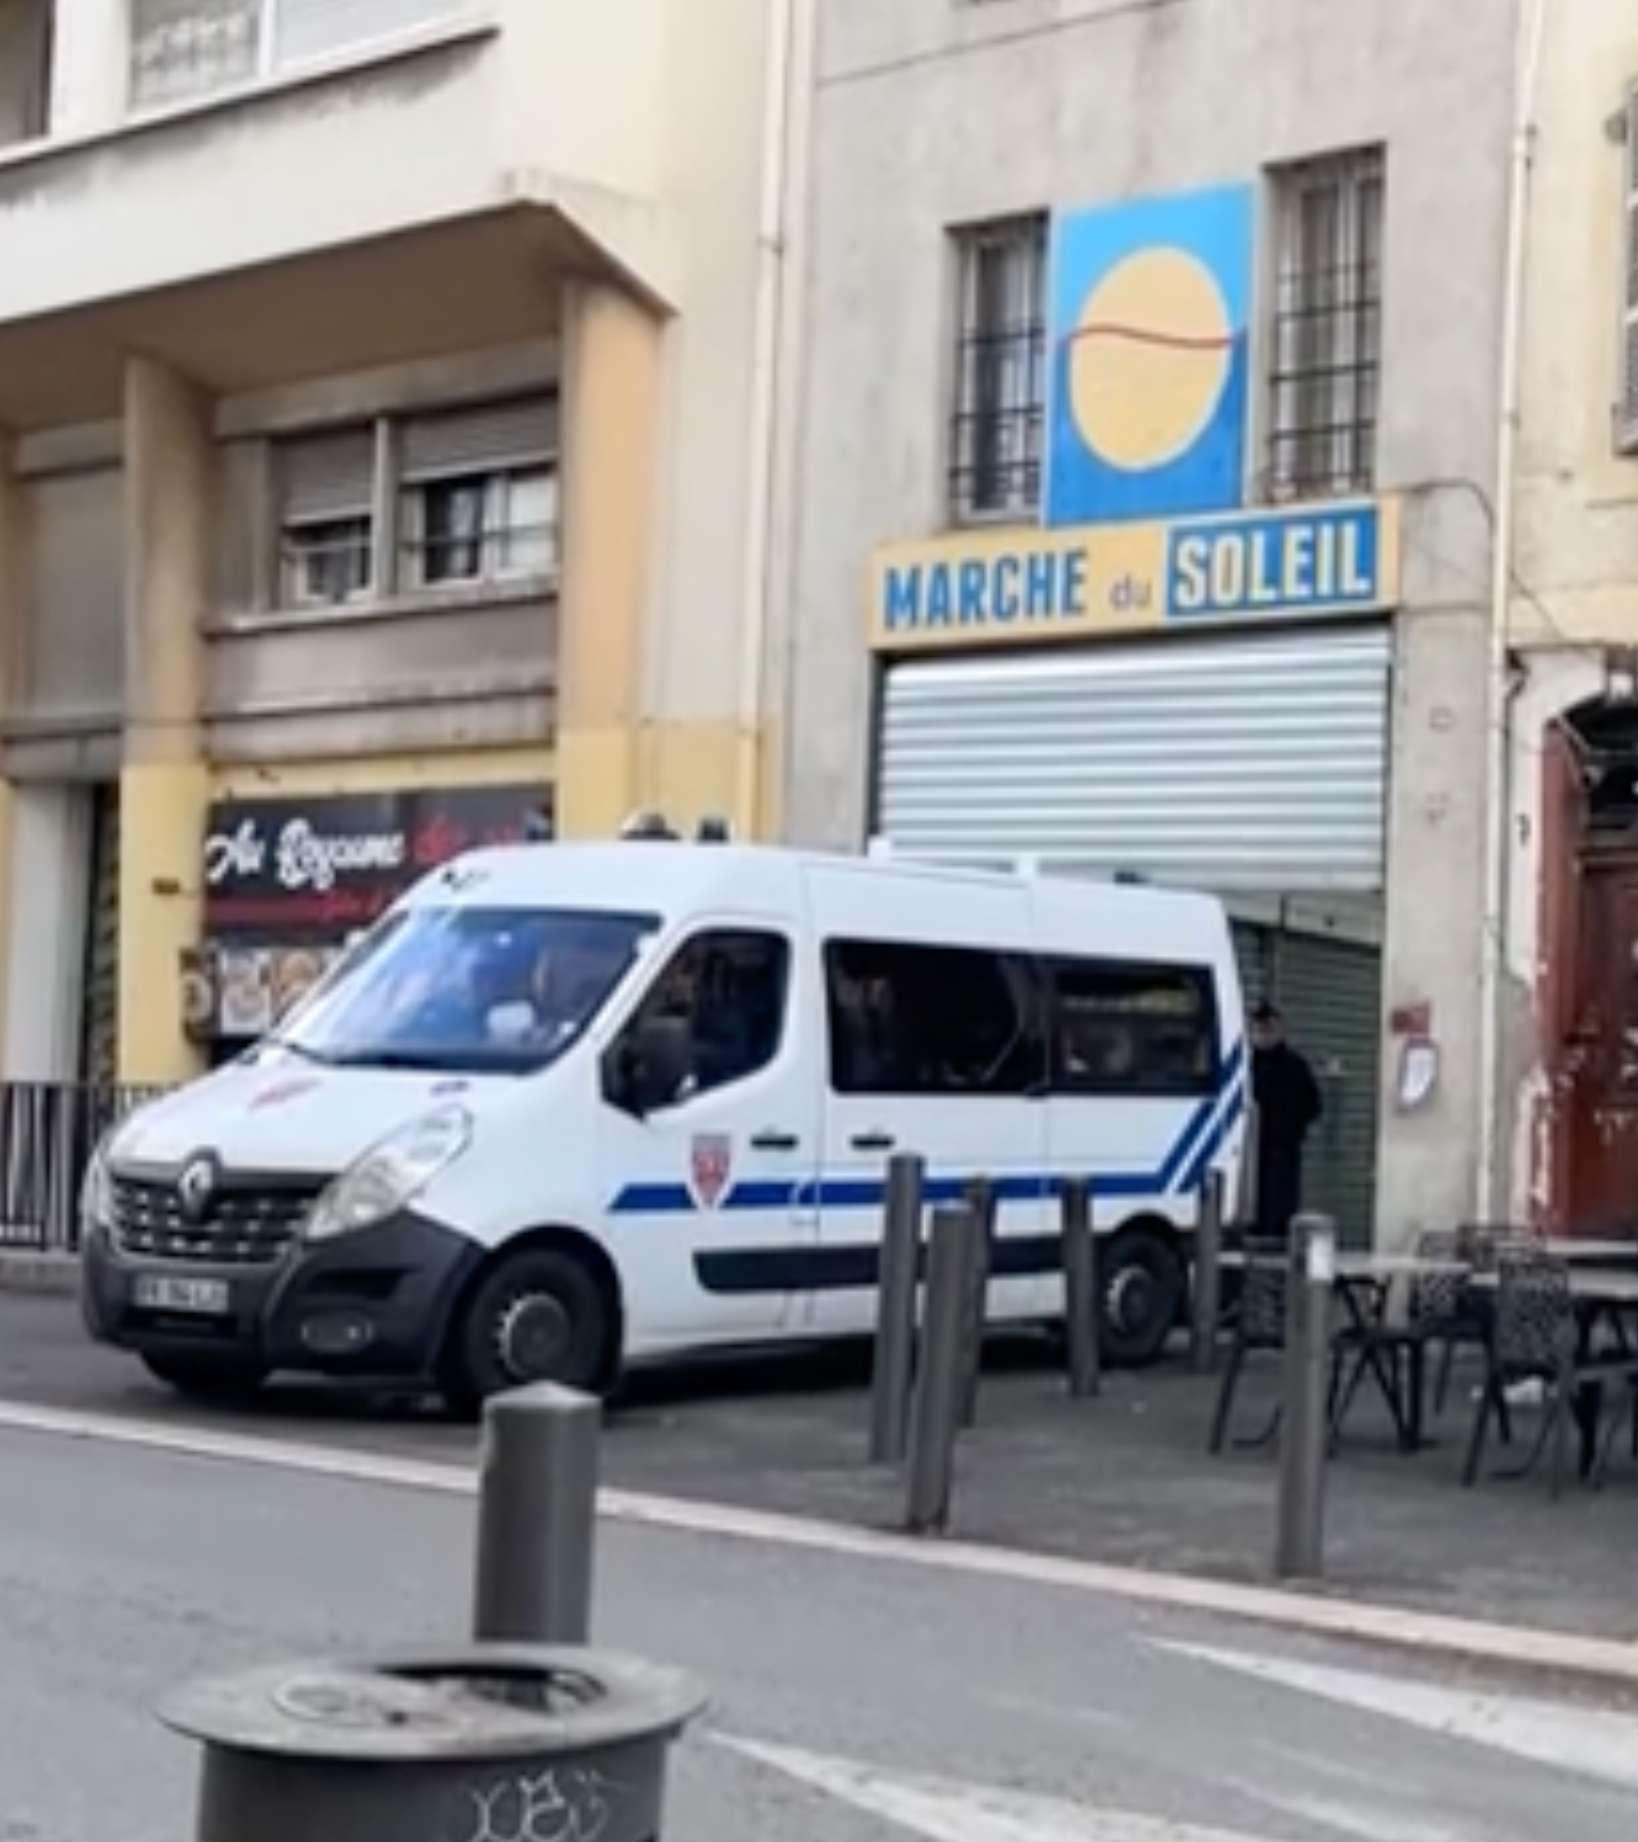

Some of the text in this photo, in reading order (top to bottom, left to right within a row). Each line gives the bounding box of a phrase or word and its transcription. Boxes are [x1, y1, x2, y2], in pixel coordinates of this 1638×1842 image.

[883, 522, 1372, 630] MARCHE du SOLEIL
[203, 817, 266, 885] Au
